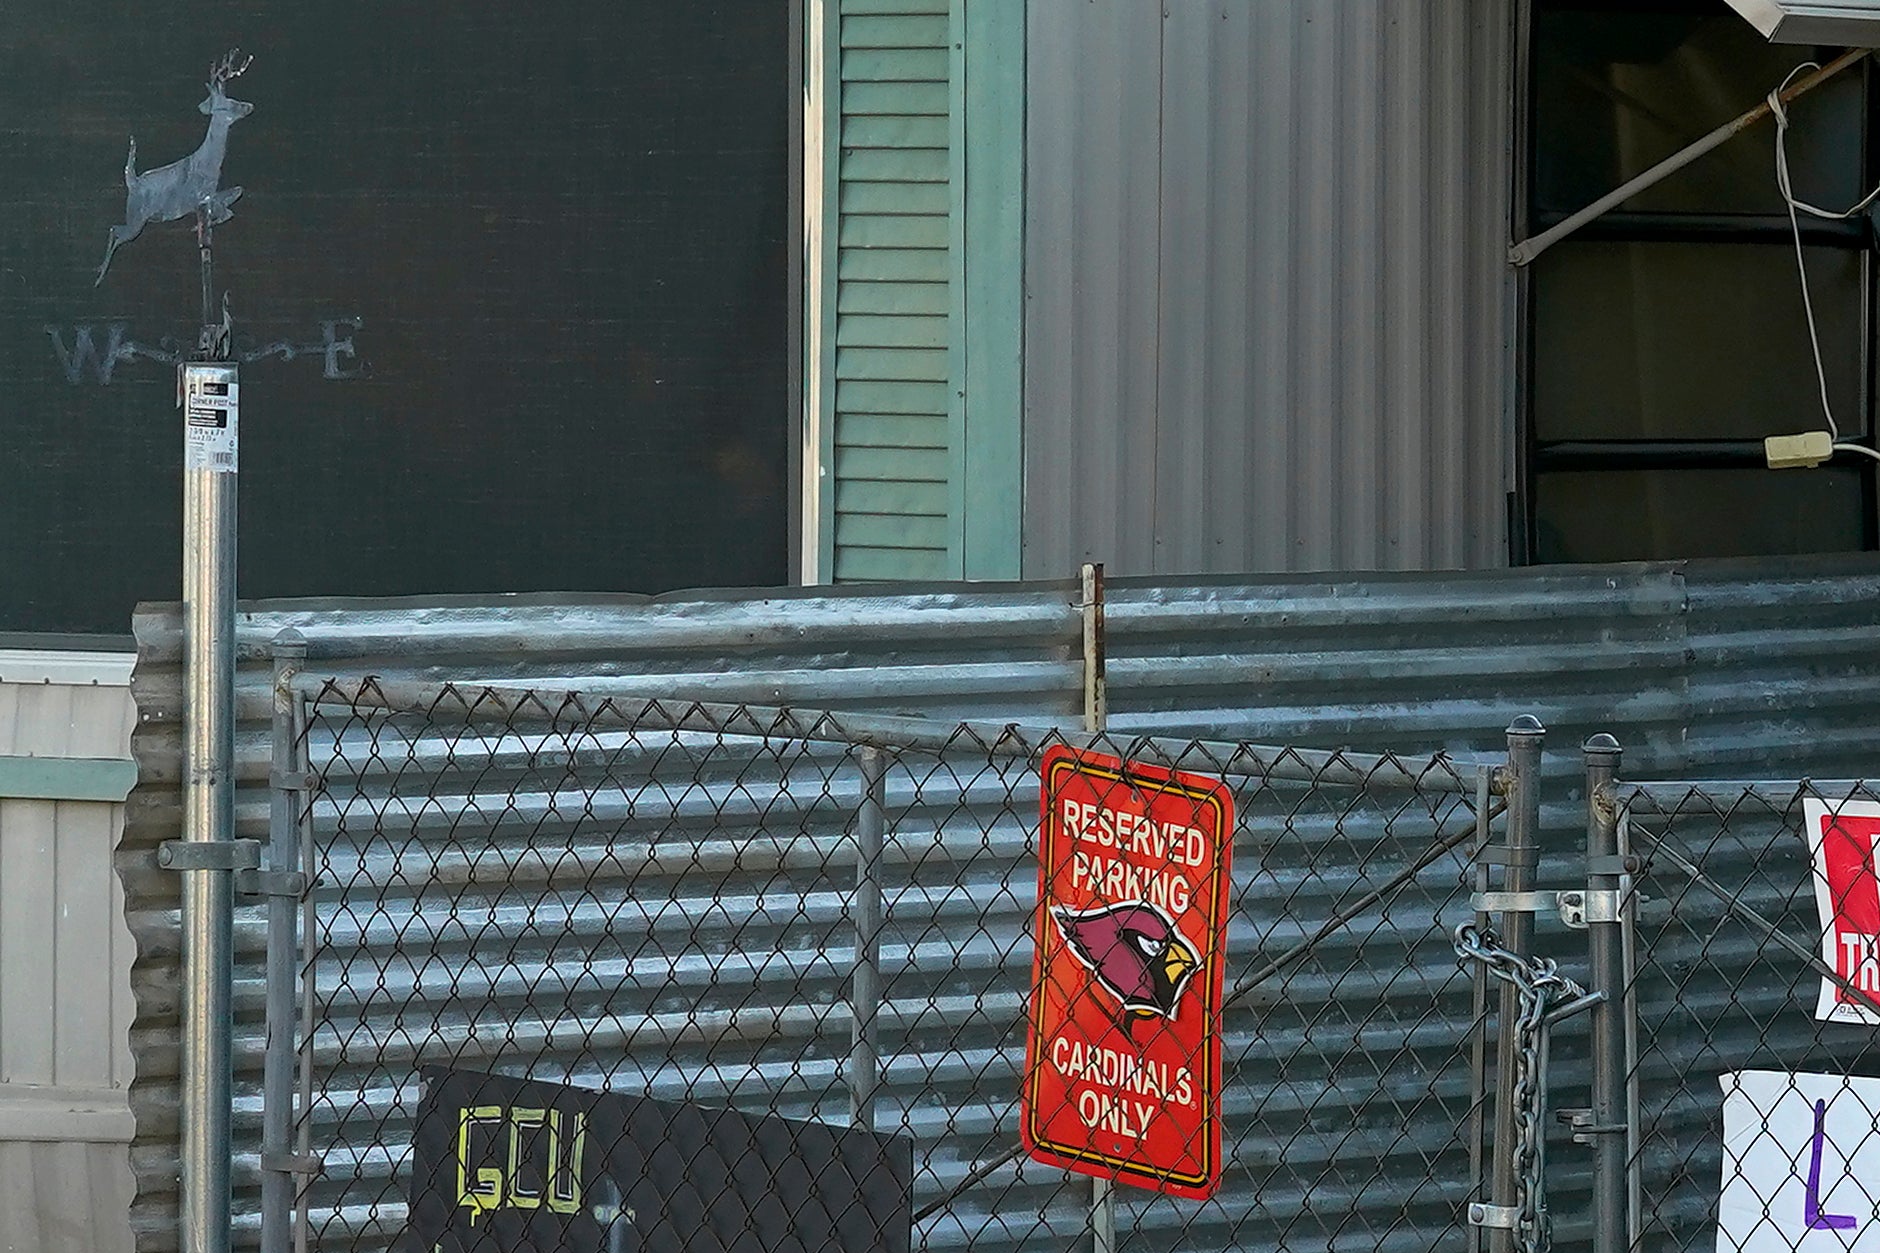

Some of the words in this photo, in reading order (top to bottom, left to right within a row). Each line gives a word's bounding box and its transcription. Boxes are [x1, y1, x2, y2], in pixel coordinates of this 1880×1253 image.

[1062, 798, 1206, 867] RESERVED
[1072, 851, 1190, 914] PARKING
[1052, 1036, 1193, 1107] CARDINALS
[1078, 1089, 1156, 1141] ONLY
